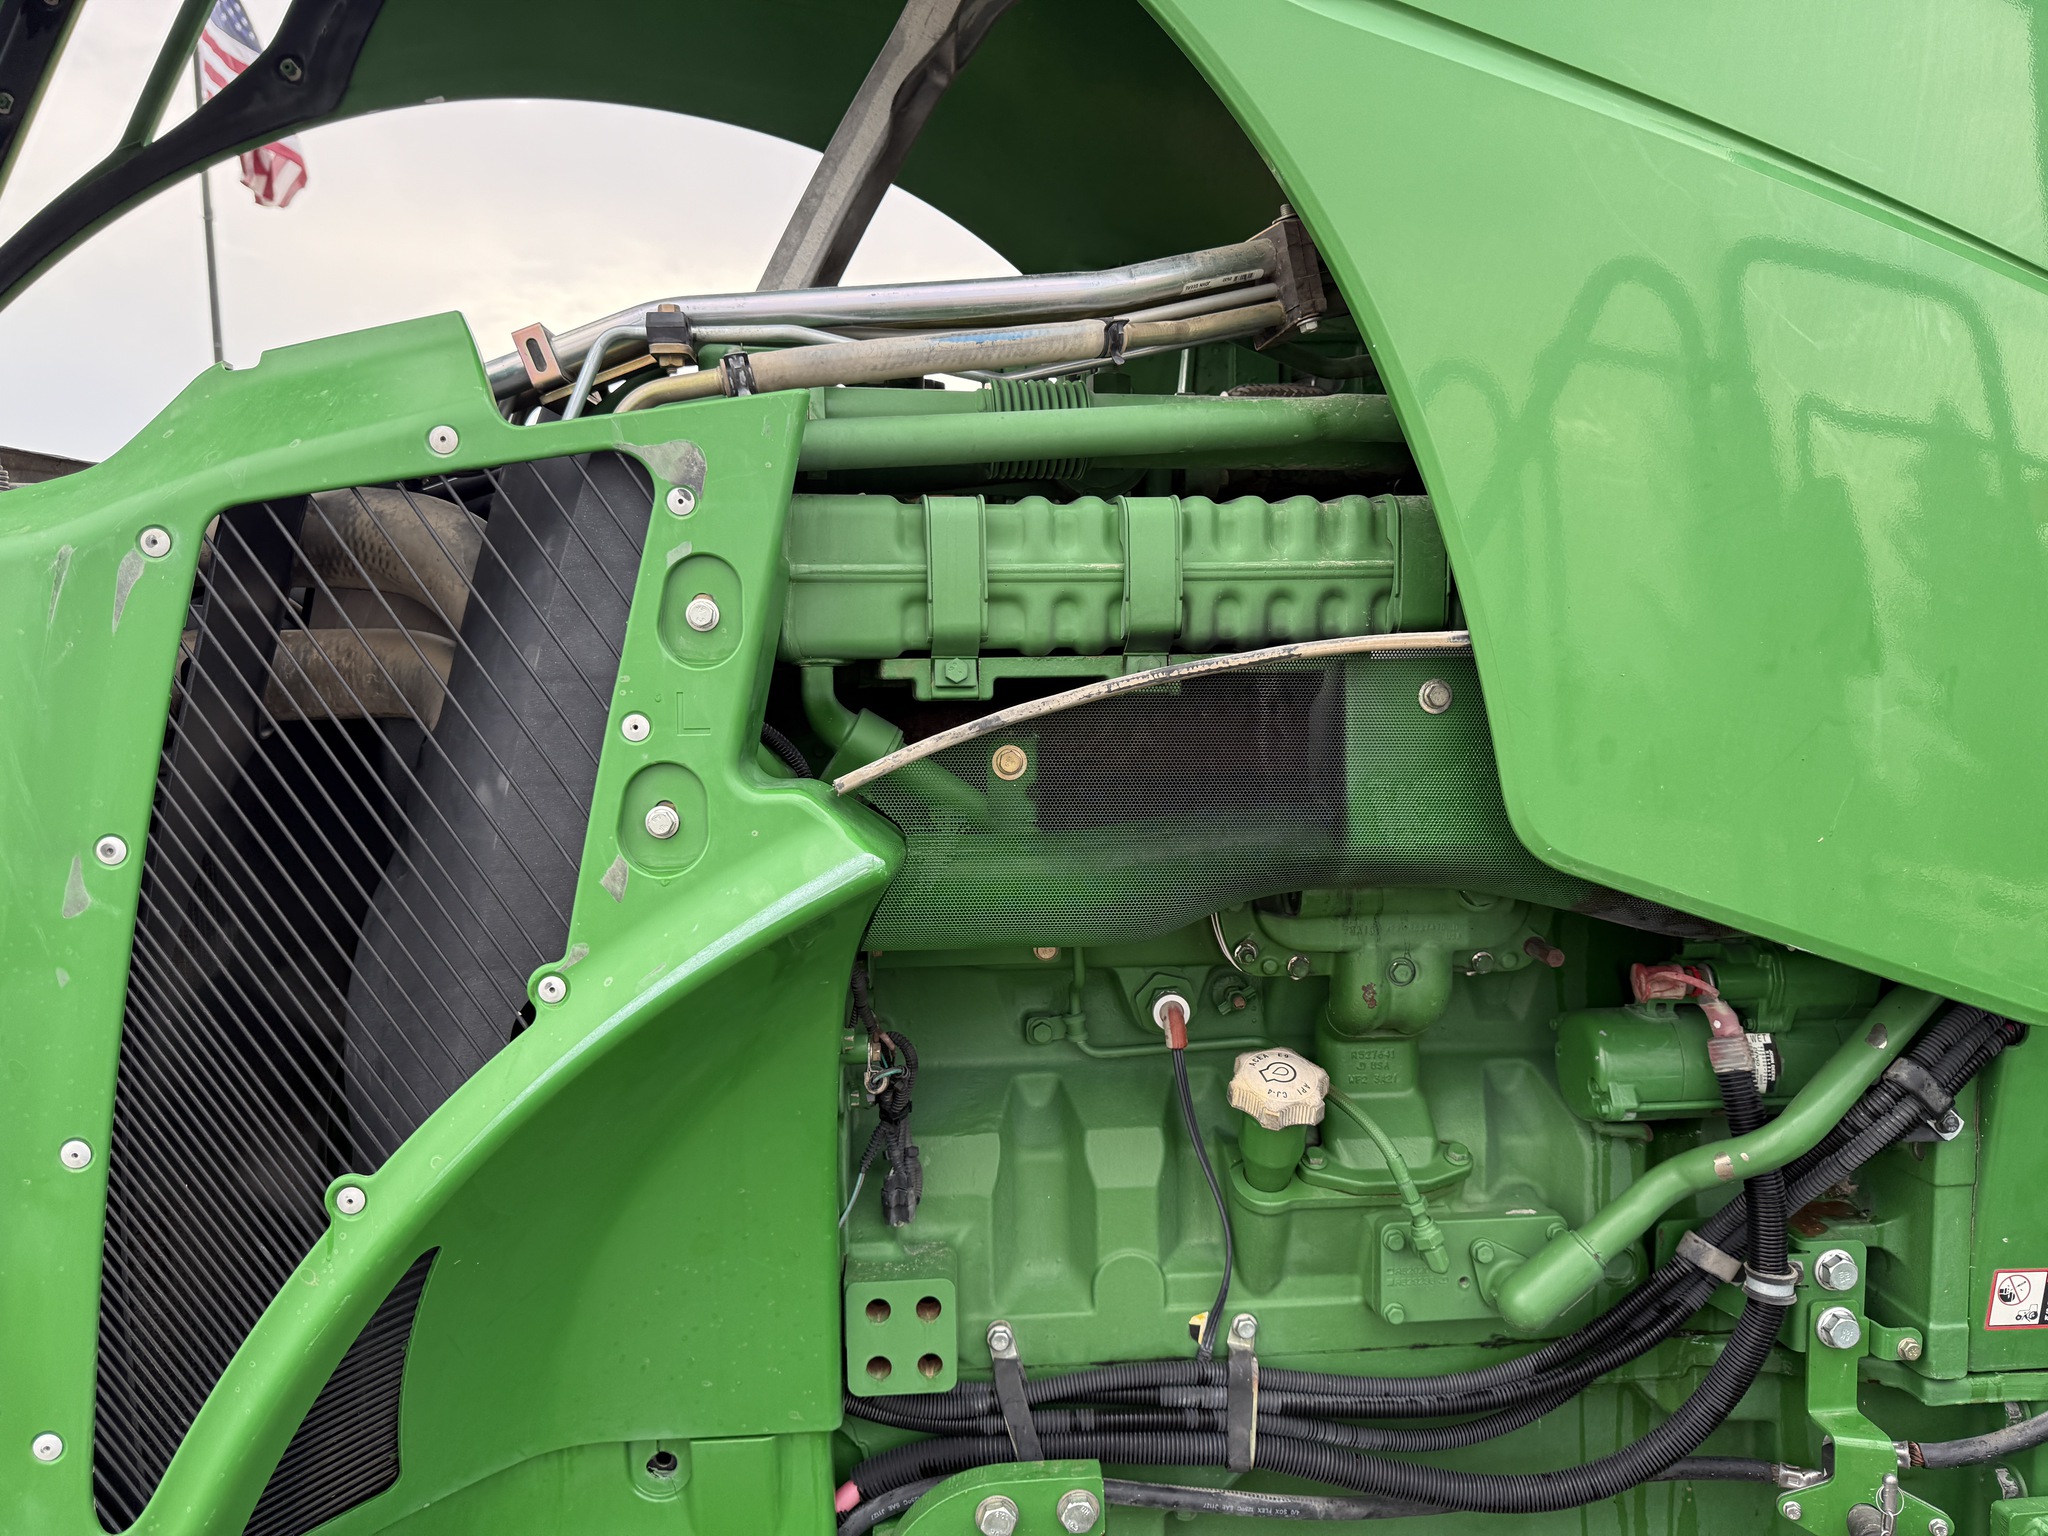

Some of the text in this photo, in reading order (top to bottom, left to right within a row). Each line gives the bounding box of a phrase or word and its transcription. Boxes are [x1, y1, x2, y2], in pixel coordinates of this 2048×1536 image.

[676, 691, 712, 736] L
[1249, 1053, 1268, 1067] ACEA
[1370, 1061, 1390, 1070] USA
[1267, 1083, 1311, 1099] API CJ-4
[887, 1502, 900, 1511] SAE
[1202, 1502, 1219, 1511] J1127
[1222, 1503, 1234, 1511] SAE
[1257, 1506, 1272, 1514] FLEX
